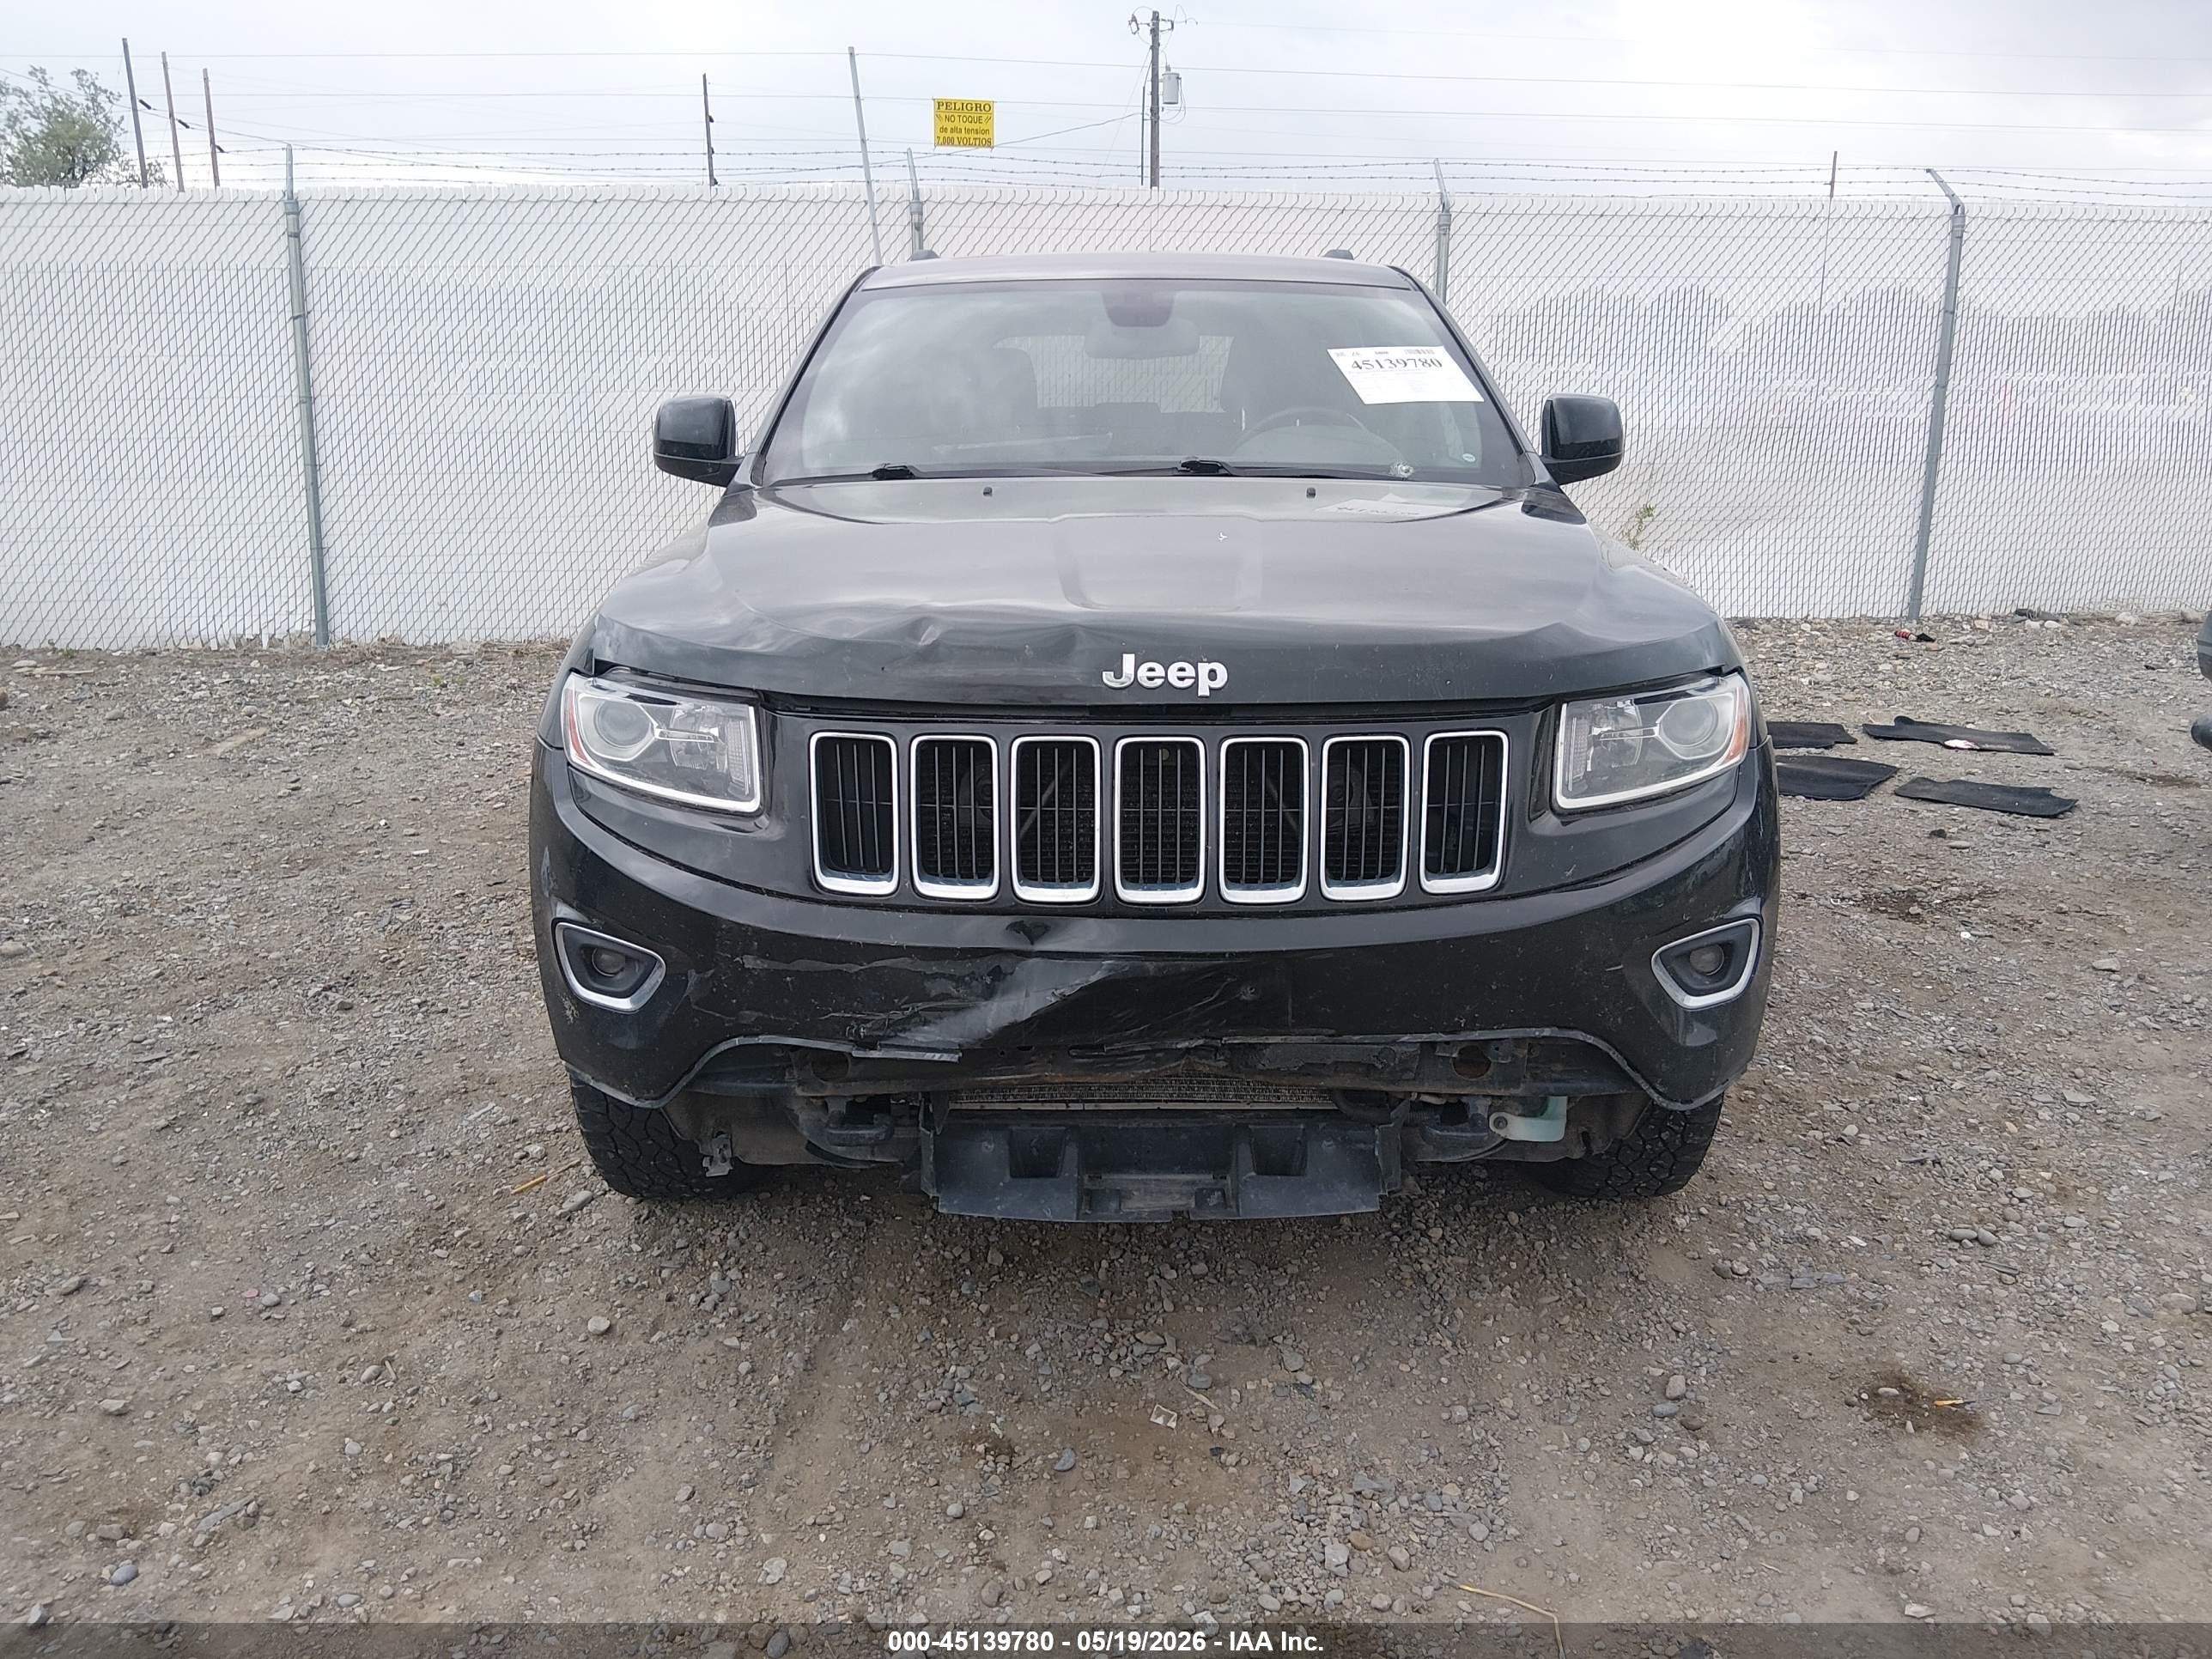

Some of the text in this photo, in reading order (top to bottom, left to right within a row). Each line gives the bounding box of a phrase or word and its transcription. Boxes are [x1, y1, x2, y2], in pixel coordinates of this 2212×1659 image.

[937, 101, 991, 112] PELIGRO
[945, 114, 983, 124] NO TOQUE
[957, 137, 992, 146] VOLTIOS
[1351, 358, 1443, 370] 45139780
[1102, 653, 1228, 697] Jeep
